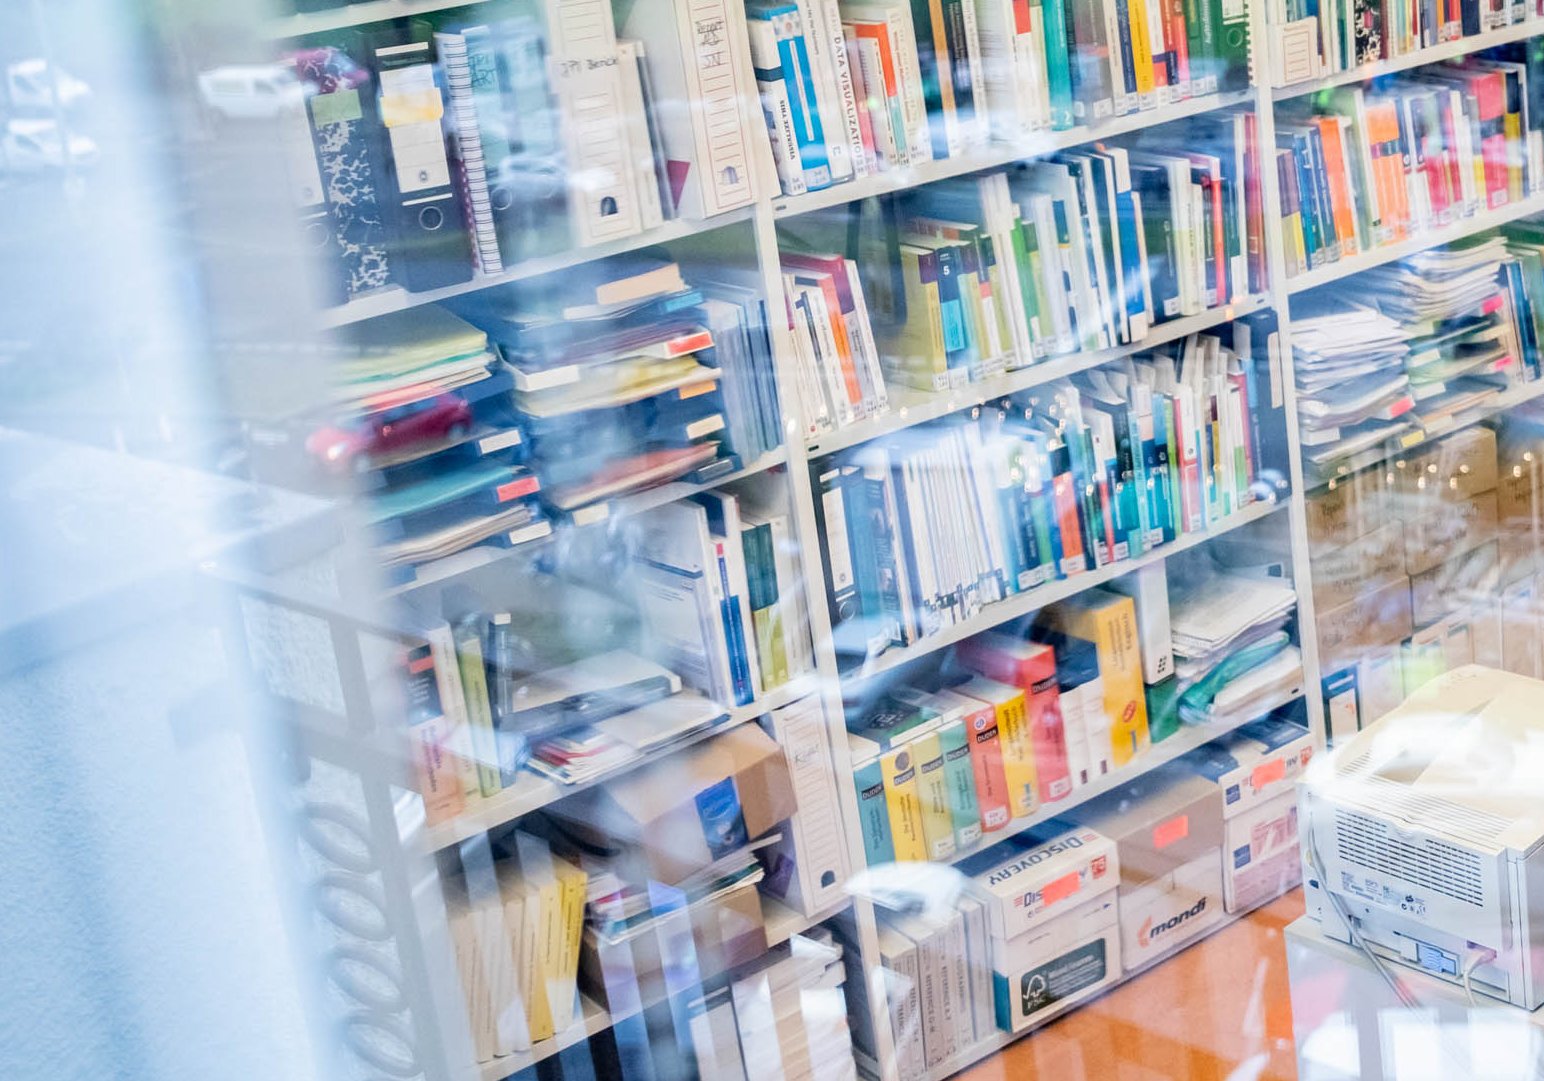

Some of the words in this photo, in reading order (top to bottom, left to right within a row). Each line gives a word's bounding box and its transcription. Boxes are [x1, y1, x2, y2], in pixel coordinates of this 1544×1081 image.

[833, 36, 845, 67] DATA
[779, 99, 787, 117] THIS
[782, 119, 796, 159] VISUALIZE
[943, 265, 950, 275] 5
[977, 728, 998, 742] DUDEN
[947, 745, 969, 760] DUDEN
[921, 757, 943, 773] DUDEN
[862, 784, 884, 799] DUDEN
[989, 836, 1083, 885] DISCOVERY
[1149, 896, 1207, 938] mondi
